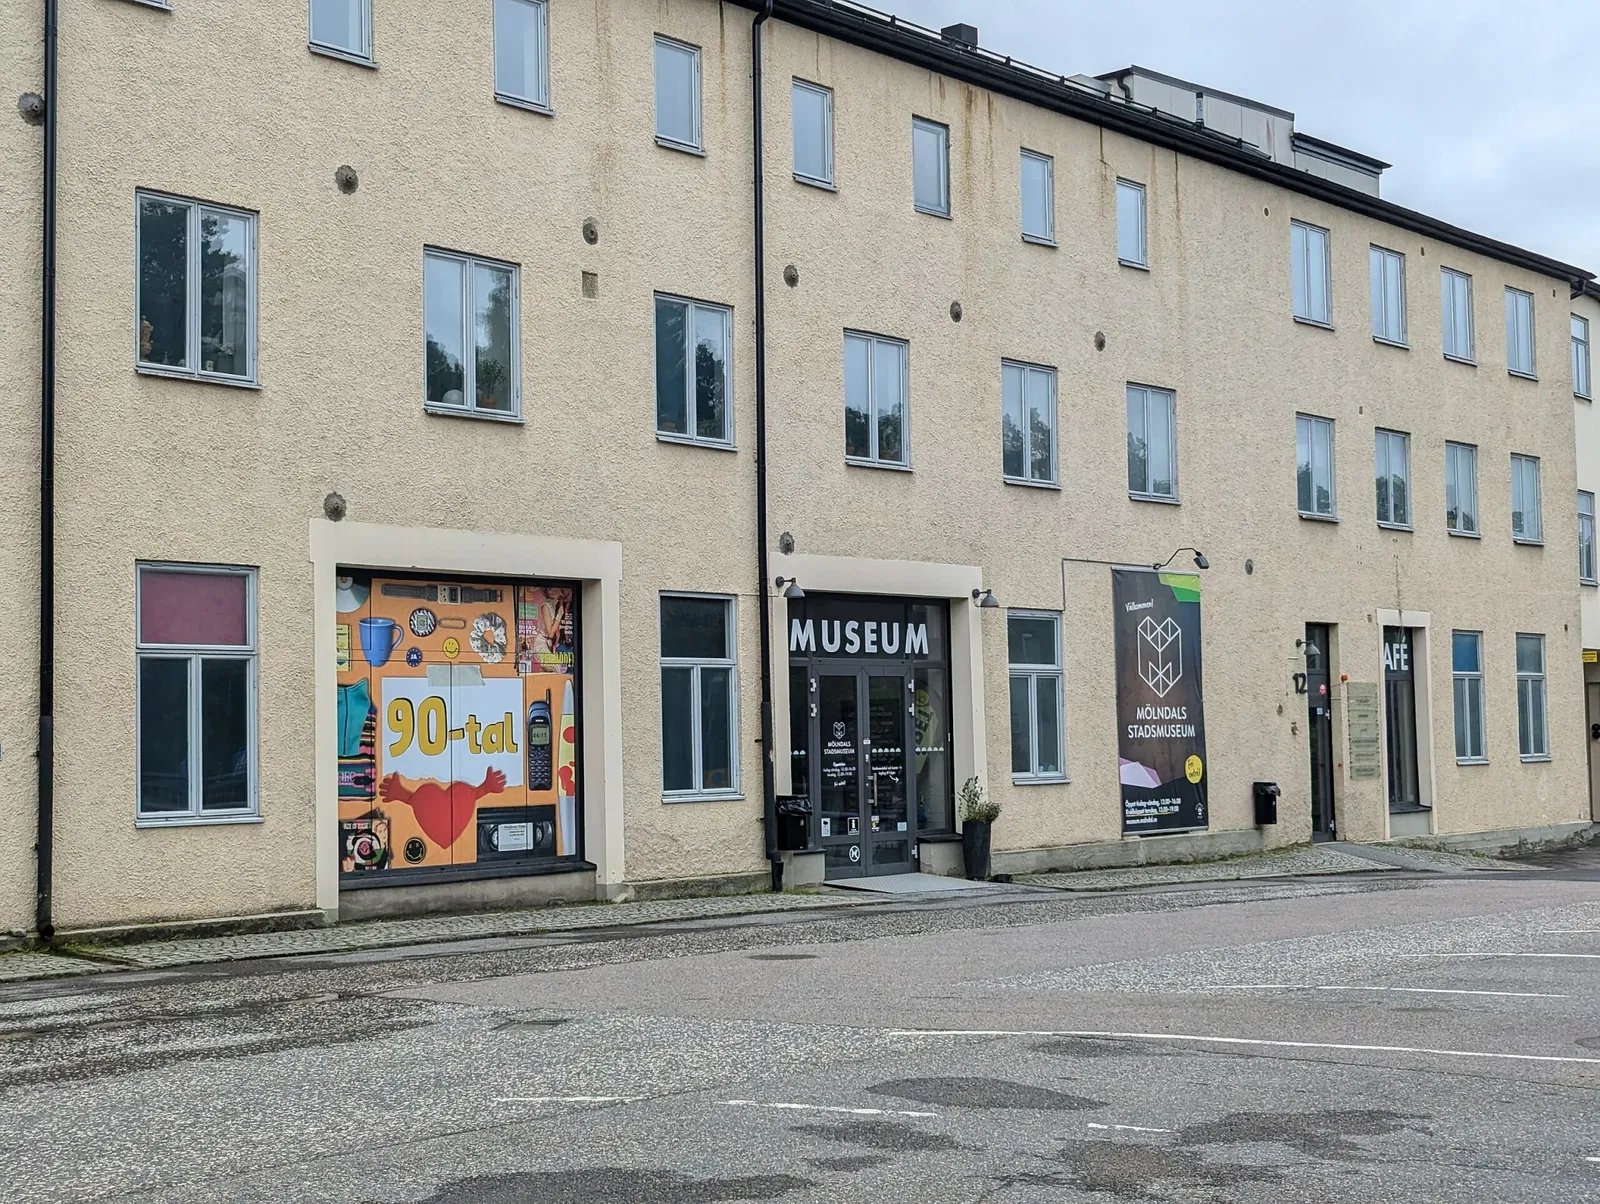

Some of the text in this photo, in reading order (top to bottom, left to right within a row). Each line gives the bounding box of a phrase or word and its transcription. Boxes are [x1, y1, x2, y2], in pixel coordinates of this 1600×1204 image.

[790, 618, 929, 654] MUSEUM
[1292, 672, 1307, 694] 12
[1136, 703, 1187, 720] MÖLNDALS
[387, 695, 519, 758] 90-tal
[1127, 724, 1196, 739] STADSMUSEUM
